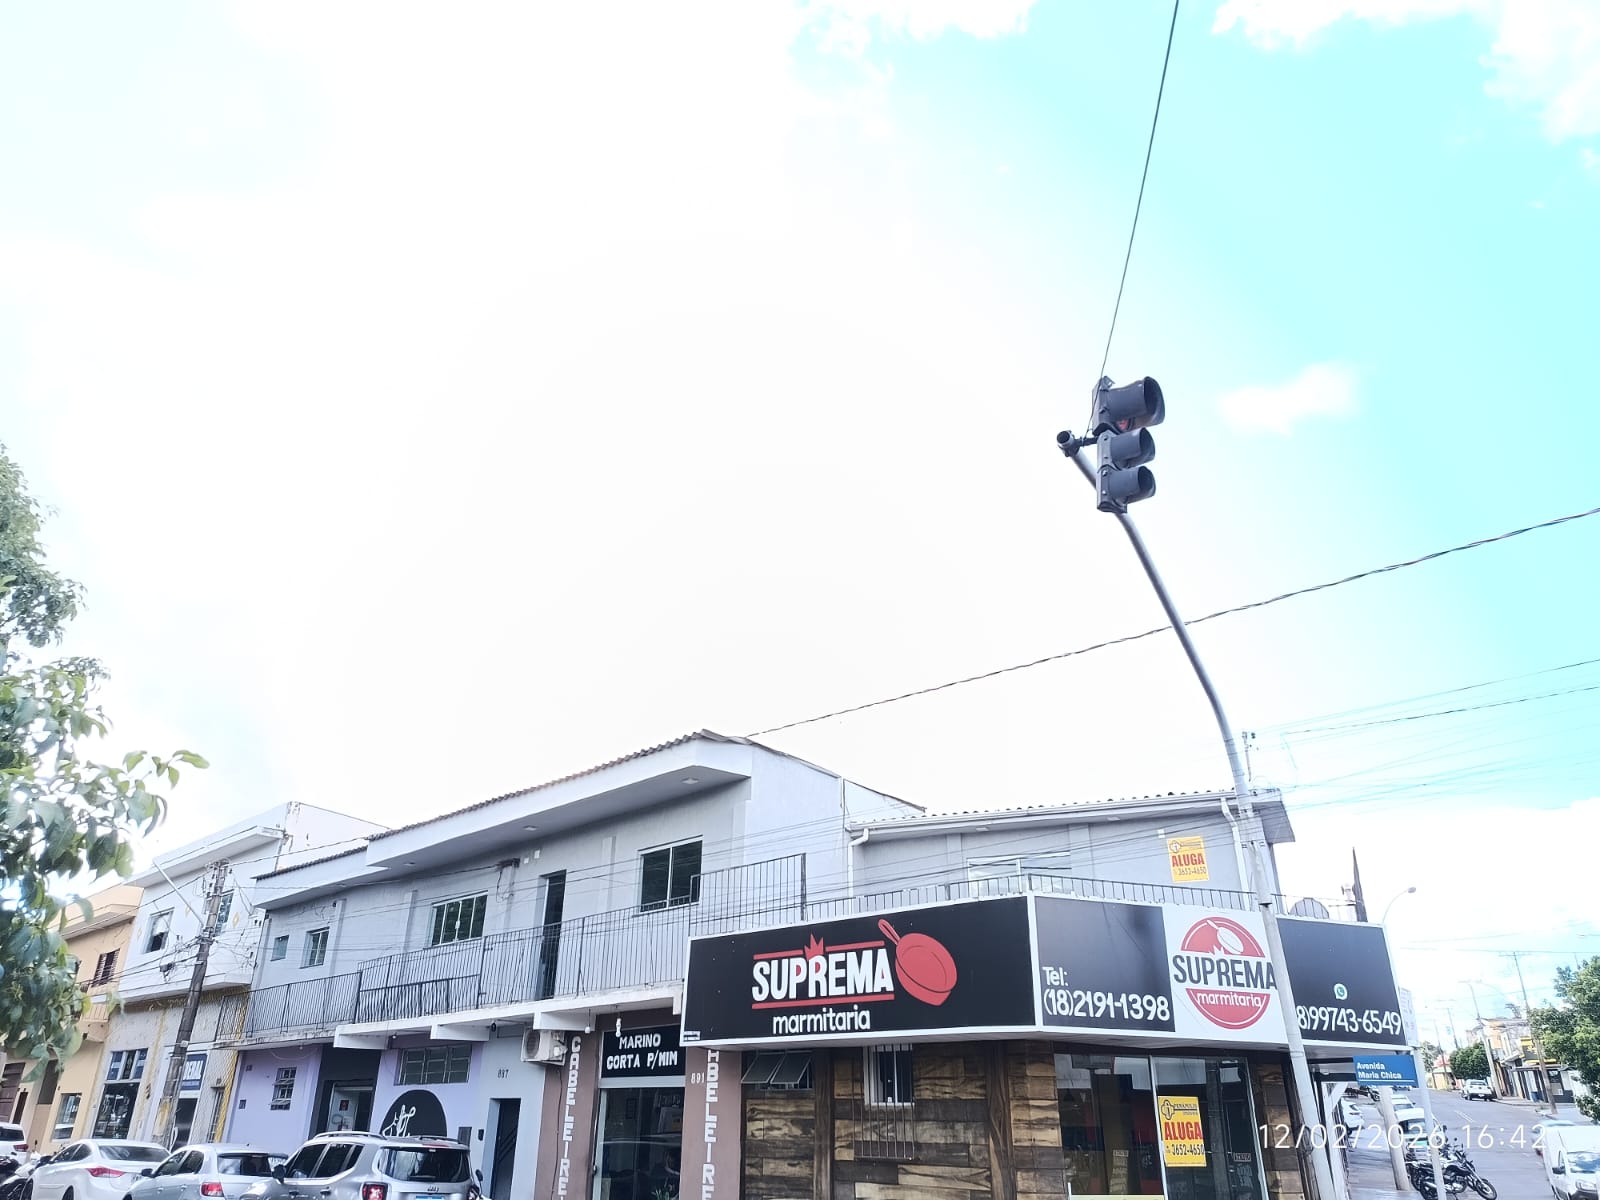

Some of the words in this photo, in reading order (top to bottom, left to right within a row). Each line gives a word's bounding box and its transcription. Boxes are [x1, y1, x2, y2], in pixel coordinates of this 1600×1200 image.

[1171, 853, 1205, 867] ALUGA
[751, 948, 895, 1002] SUPREMA
[1042, 966, 1069, 986] Tel:
[1172, 954, 1277, 990] SUPREMA
[1043, 988, 1170, 1021] (18)2191-1398
[1197, 991, 1261, 1008] marmitaria
[772, 1004, 871, 1035] marmitaria
[1296, 1005, 1402, 1036] 8)99743-6549
[619, 1032, 661, 1050] MARINO
[606, 1053, 641, 1070] CORTA
[1356, 1062, 1386, 1070] Avenida
[690, 1072, 705, 1084] 891
[1380, 1071, 1402, 1079] Chica
[558, 1036, 582, 1200] CABELEIRE
[1164, 1121, 1203, 1141] ALUGA
[1259, 1123, 1447, 1150] 12/02/2026
[1462, 1124, 1548, 1149] 16:42
